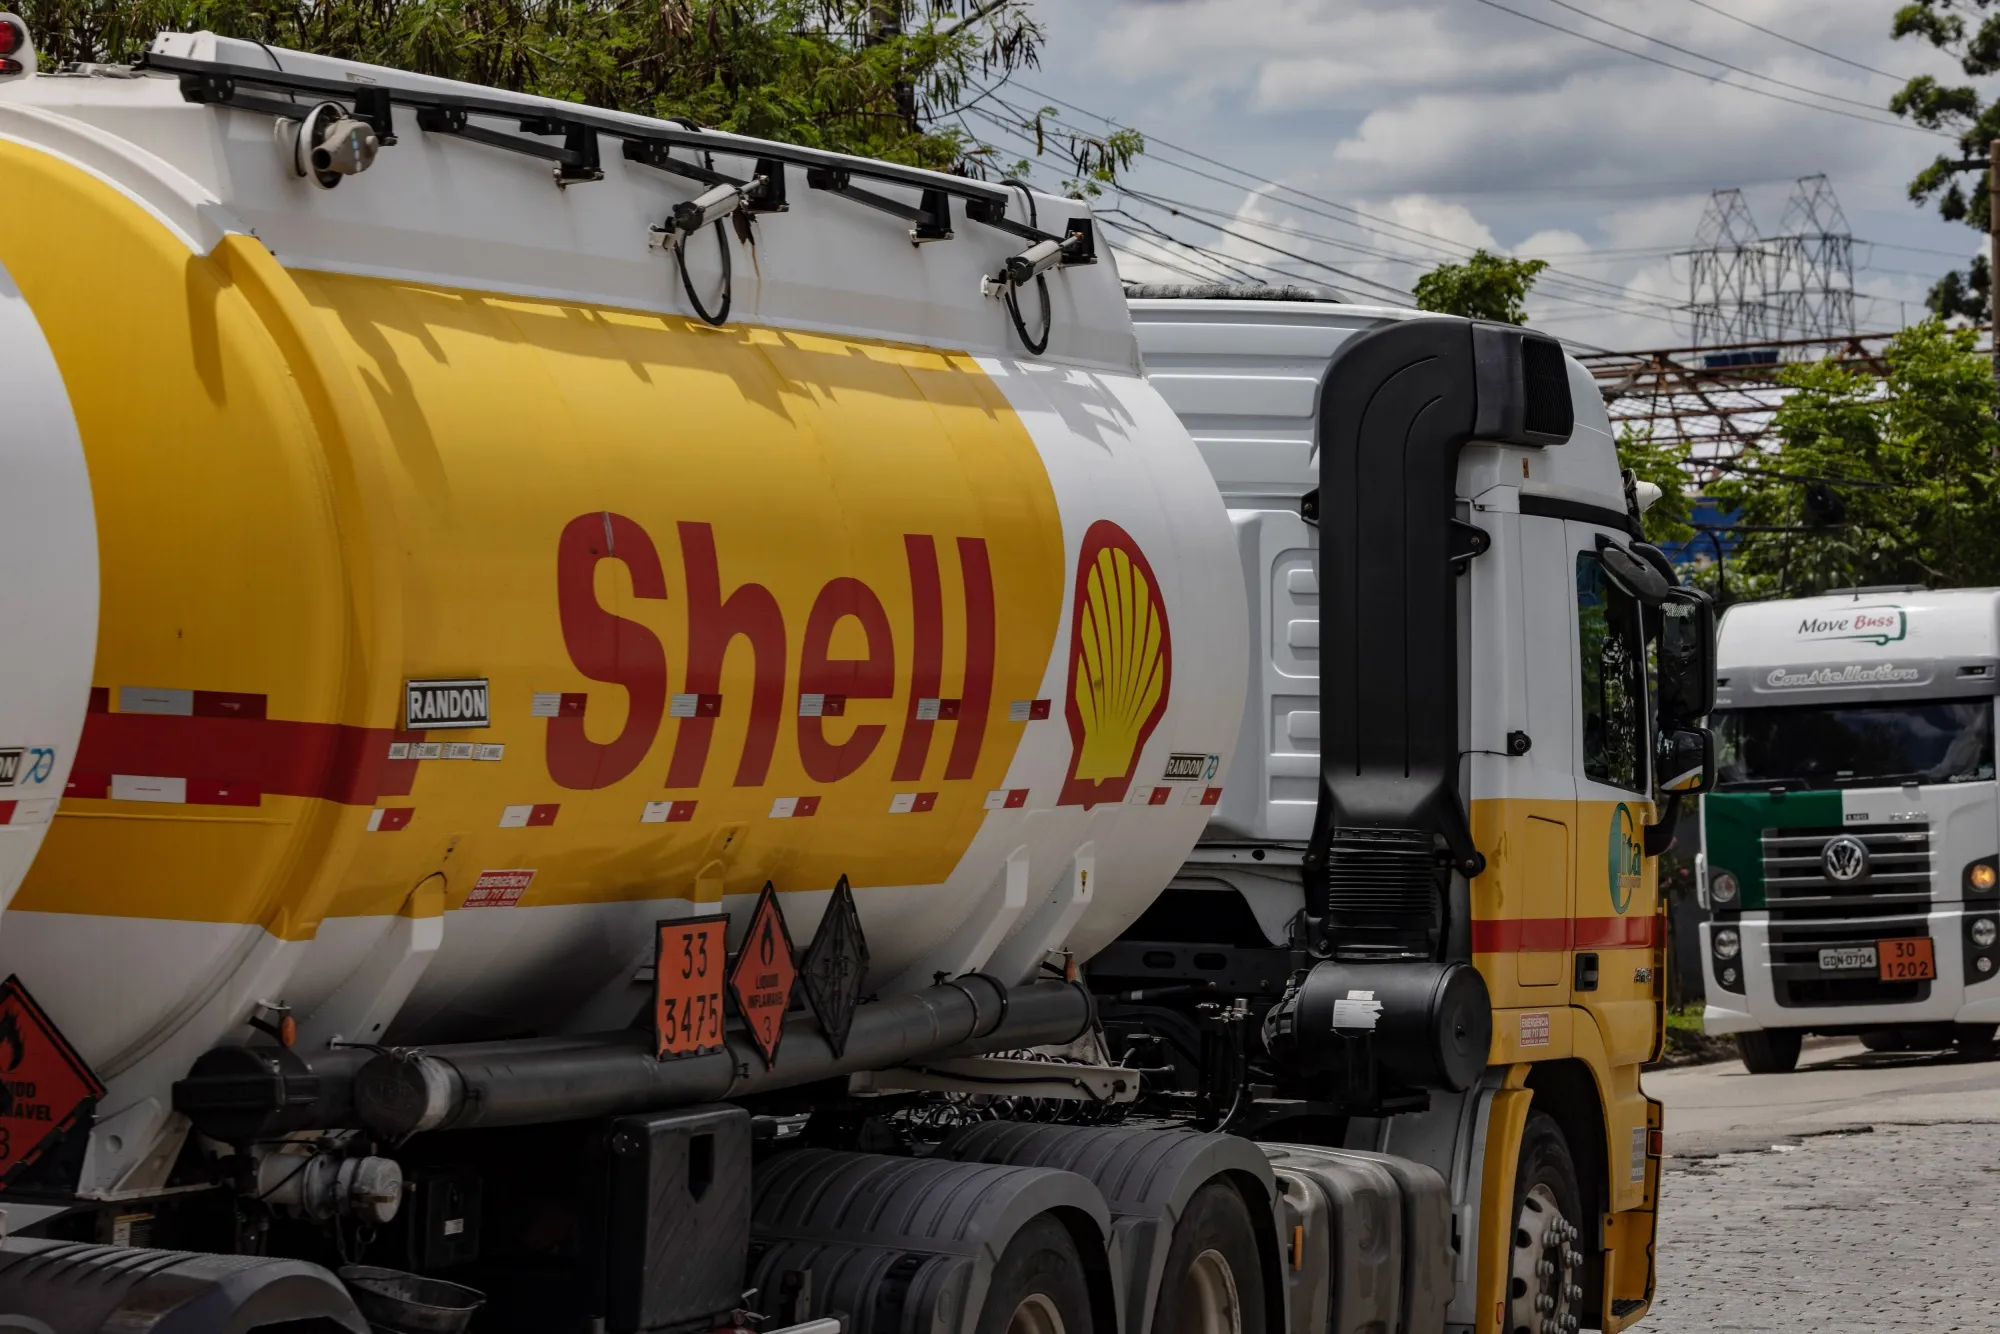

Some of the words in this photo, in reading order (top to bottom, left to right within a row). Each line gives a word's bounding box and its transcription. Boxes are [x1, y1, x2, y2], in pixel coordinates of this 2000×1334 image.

[1798, 618, 1849, 634] Move
[1853, 615, 1894, 630] Buss
[545, 511, 996, 791] Shell
[1767, 663, 1918, 687] Constellation
[409, 689, 486, 719] RANDON
[1166, 759, 1203, 775] RANDON
[476, 873, 530, 887] EMERGÊNCIA
[681, 932, 708, 979] 33
[1895, 942, 1916, 958] 30
[1887, 961, 1929, 978] 1202
[664, 993, 719, 1045] 3475
[764, 1015, 772, 1045] 3
